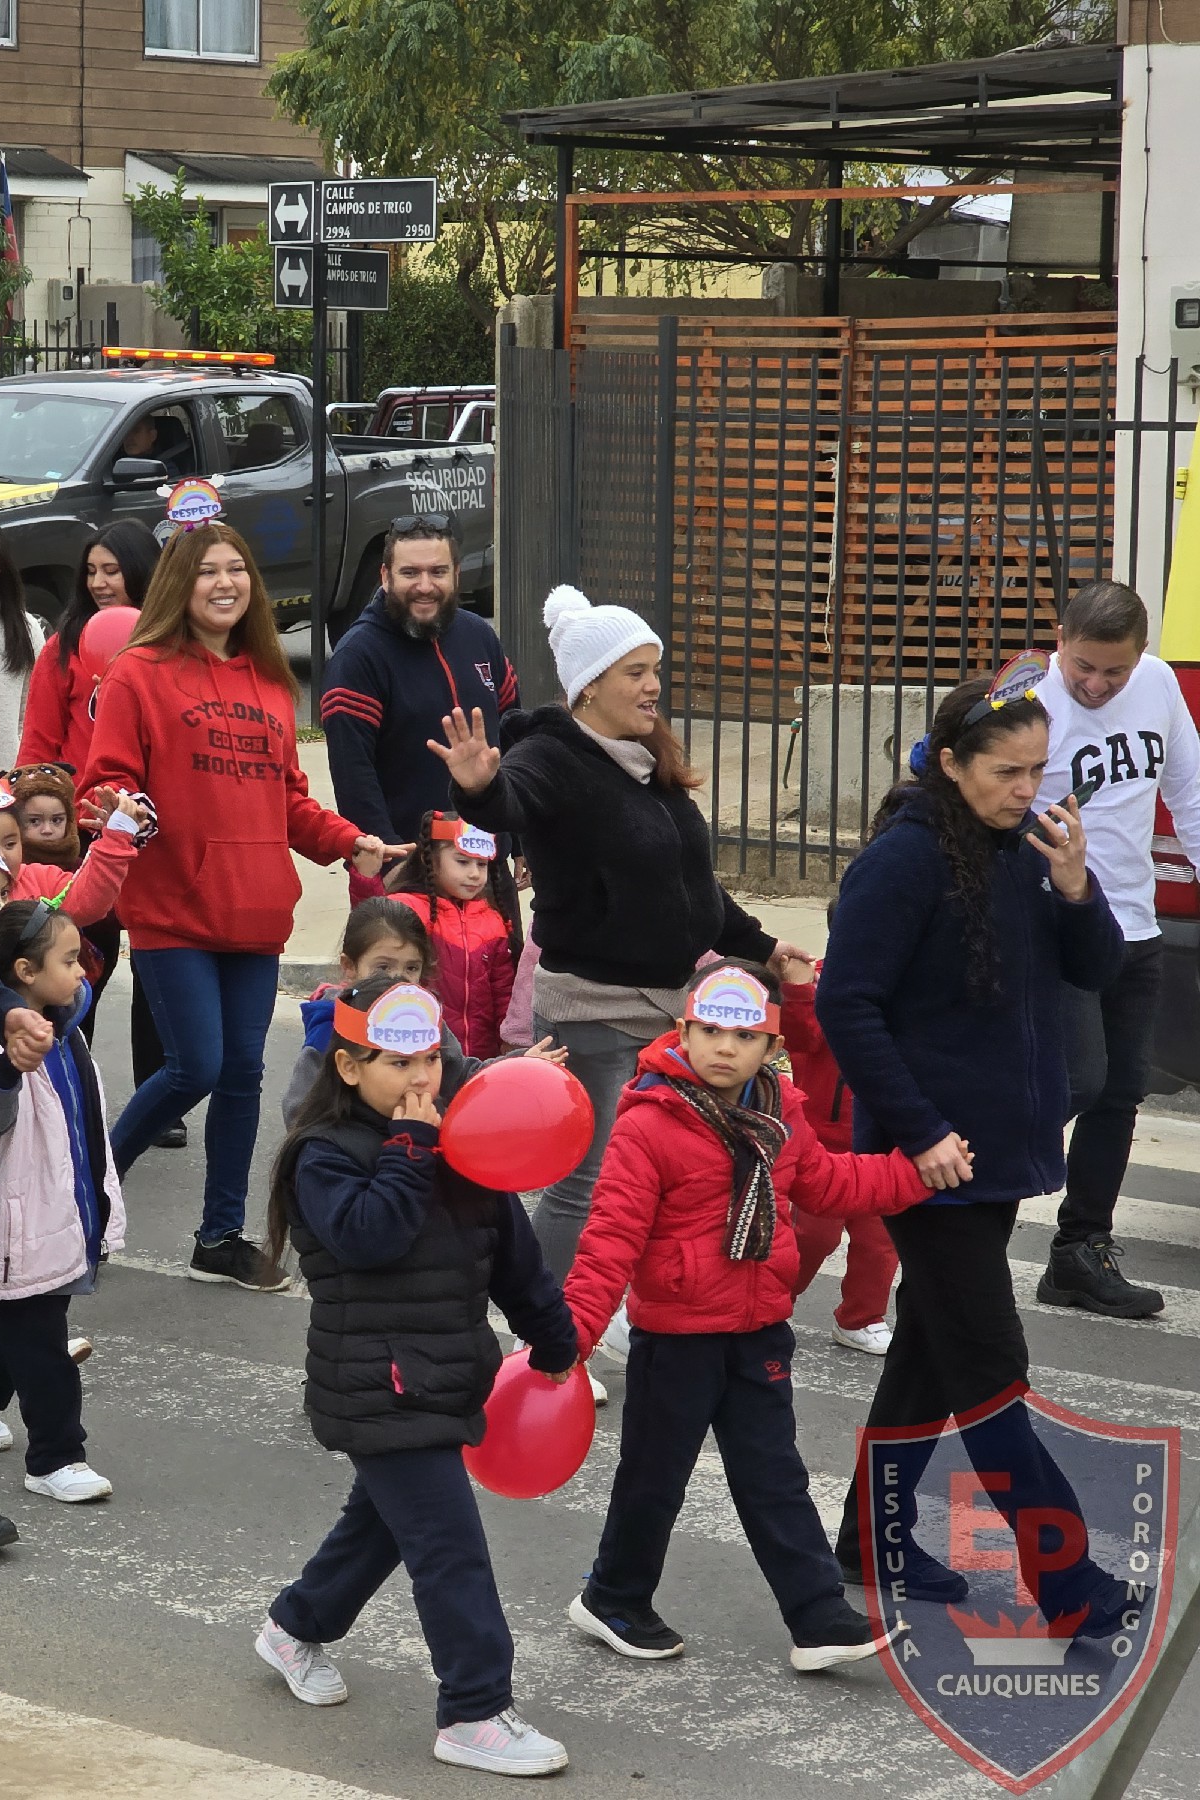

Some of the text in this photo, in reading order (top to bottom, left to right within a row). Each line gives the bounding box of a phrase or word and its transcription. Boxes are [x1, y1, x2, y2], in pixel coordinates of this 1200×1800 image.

[326, 187, 354, 200] CALLE
[326, 201, 412, 215] CAMPOS DE TRIGO
[326, 227, 350, 239] 2994
[405, 224, 431, 237] 2950
[327, 254, 342, 266] ALLE
[326, 269, 377, 283] AMPOS DE TRIGO
[405, 466, 487, 491] SEGURIDAD
[171, 504, 219, 519] RESPETO
[994, 671, 1045, 700] RESPETO
[192, 753, 283, 781] HOCKEY
[1070, 731, 1165, 793] GAP
[698, 1004, 761, 1021] RESPETO
[373, 1027, 436, 1043] RESPETO
